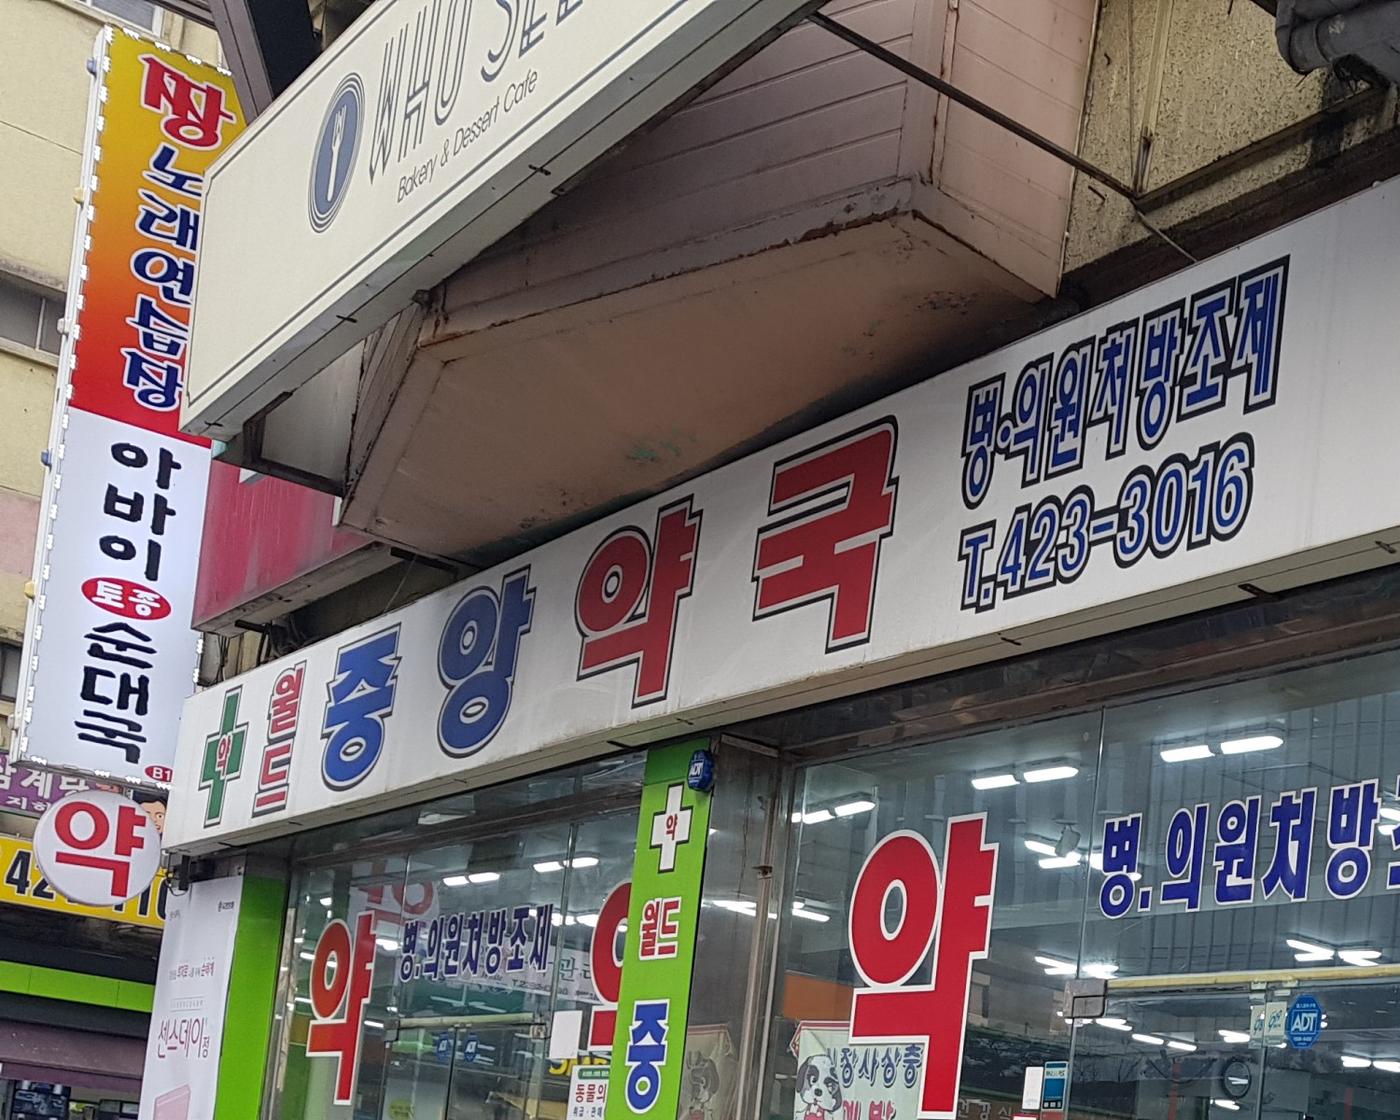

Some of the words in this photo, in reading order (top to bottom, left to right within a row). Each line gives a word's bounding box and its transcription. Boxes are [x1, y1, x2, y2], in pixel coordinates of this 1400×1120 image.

[397, 153, 437, 203] Bakery
[439, 137, 450, 168] &
[453, 95, 500, 156] Dessert
[503, 68, 539, 113] Cafe
[98, 440, 182, 583] 아바이
[958, 432, 1254, 613] T.423-3016
[94, 577, 163, 619] 토종
[322, 415, 898, 791] 중앙약국
[74, 621, 158, 764] 순대국
[217, 733, 233, 768] 약
[252, 660, 306, 818] 월드
[151, 767, 171, 782] B1
[666, 813, 678, 841] 약
[55, 801, 147, 898] 약
[638, 897, 681, 961] 월드
[849, 811, 1000, 1120] 약
[305, 909, 376, 1106] 약
[1291, 1012, 1319, 1032] ADT
[827, 1044, 924, 1088] 장사상충
